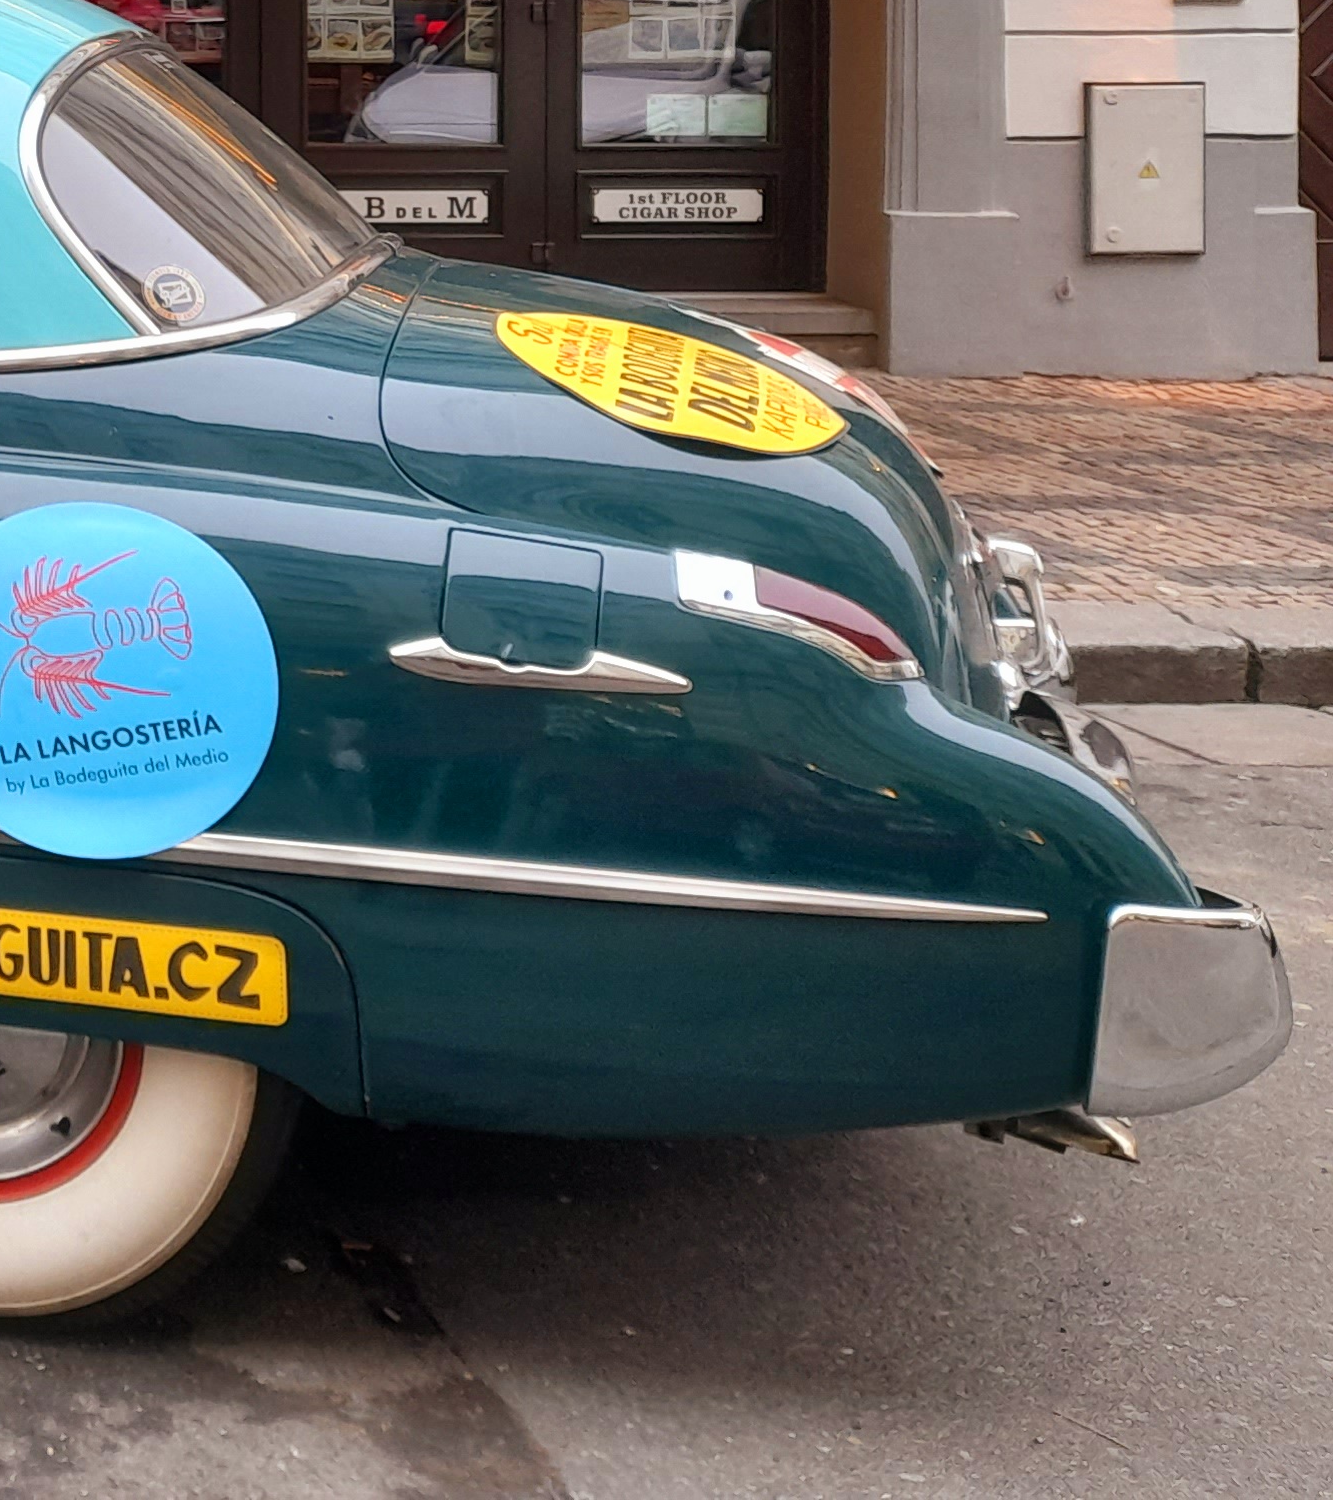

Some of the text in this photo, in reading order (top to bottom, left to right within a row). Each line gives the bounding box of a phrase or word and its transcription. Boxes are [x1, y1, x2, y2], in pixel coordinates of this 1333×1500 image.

[363, 196, 478, 220] B DEL M
[627, 192, 728, 205] 1st FLOOR
[618, 206, 739, 219] CIGAR SHOP
[36, 710, 224, 760] LANGOSTERÍA
[5, 747, 230, 795] by La Bodeguita del Medio
